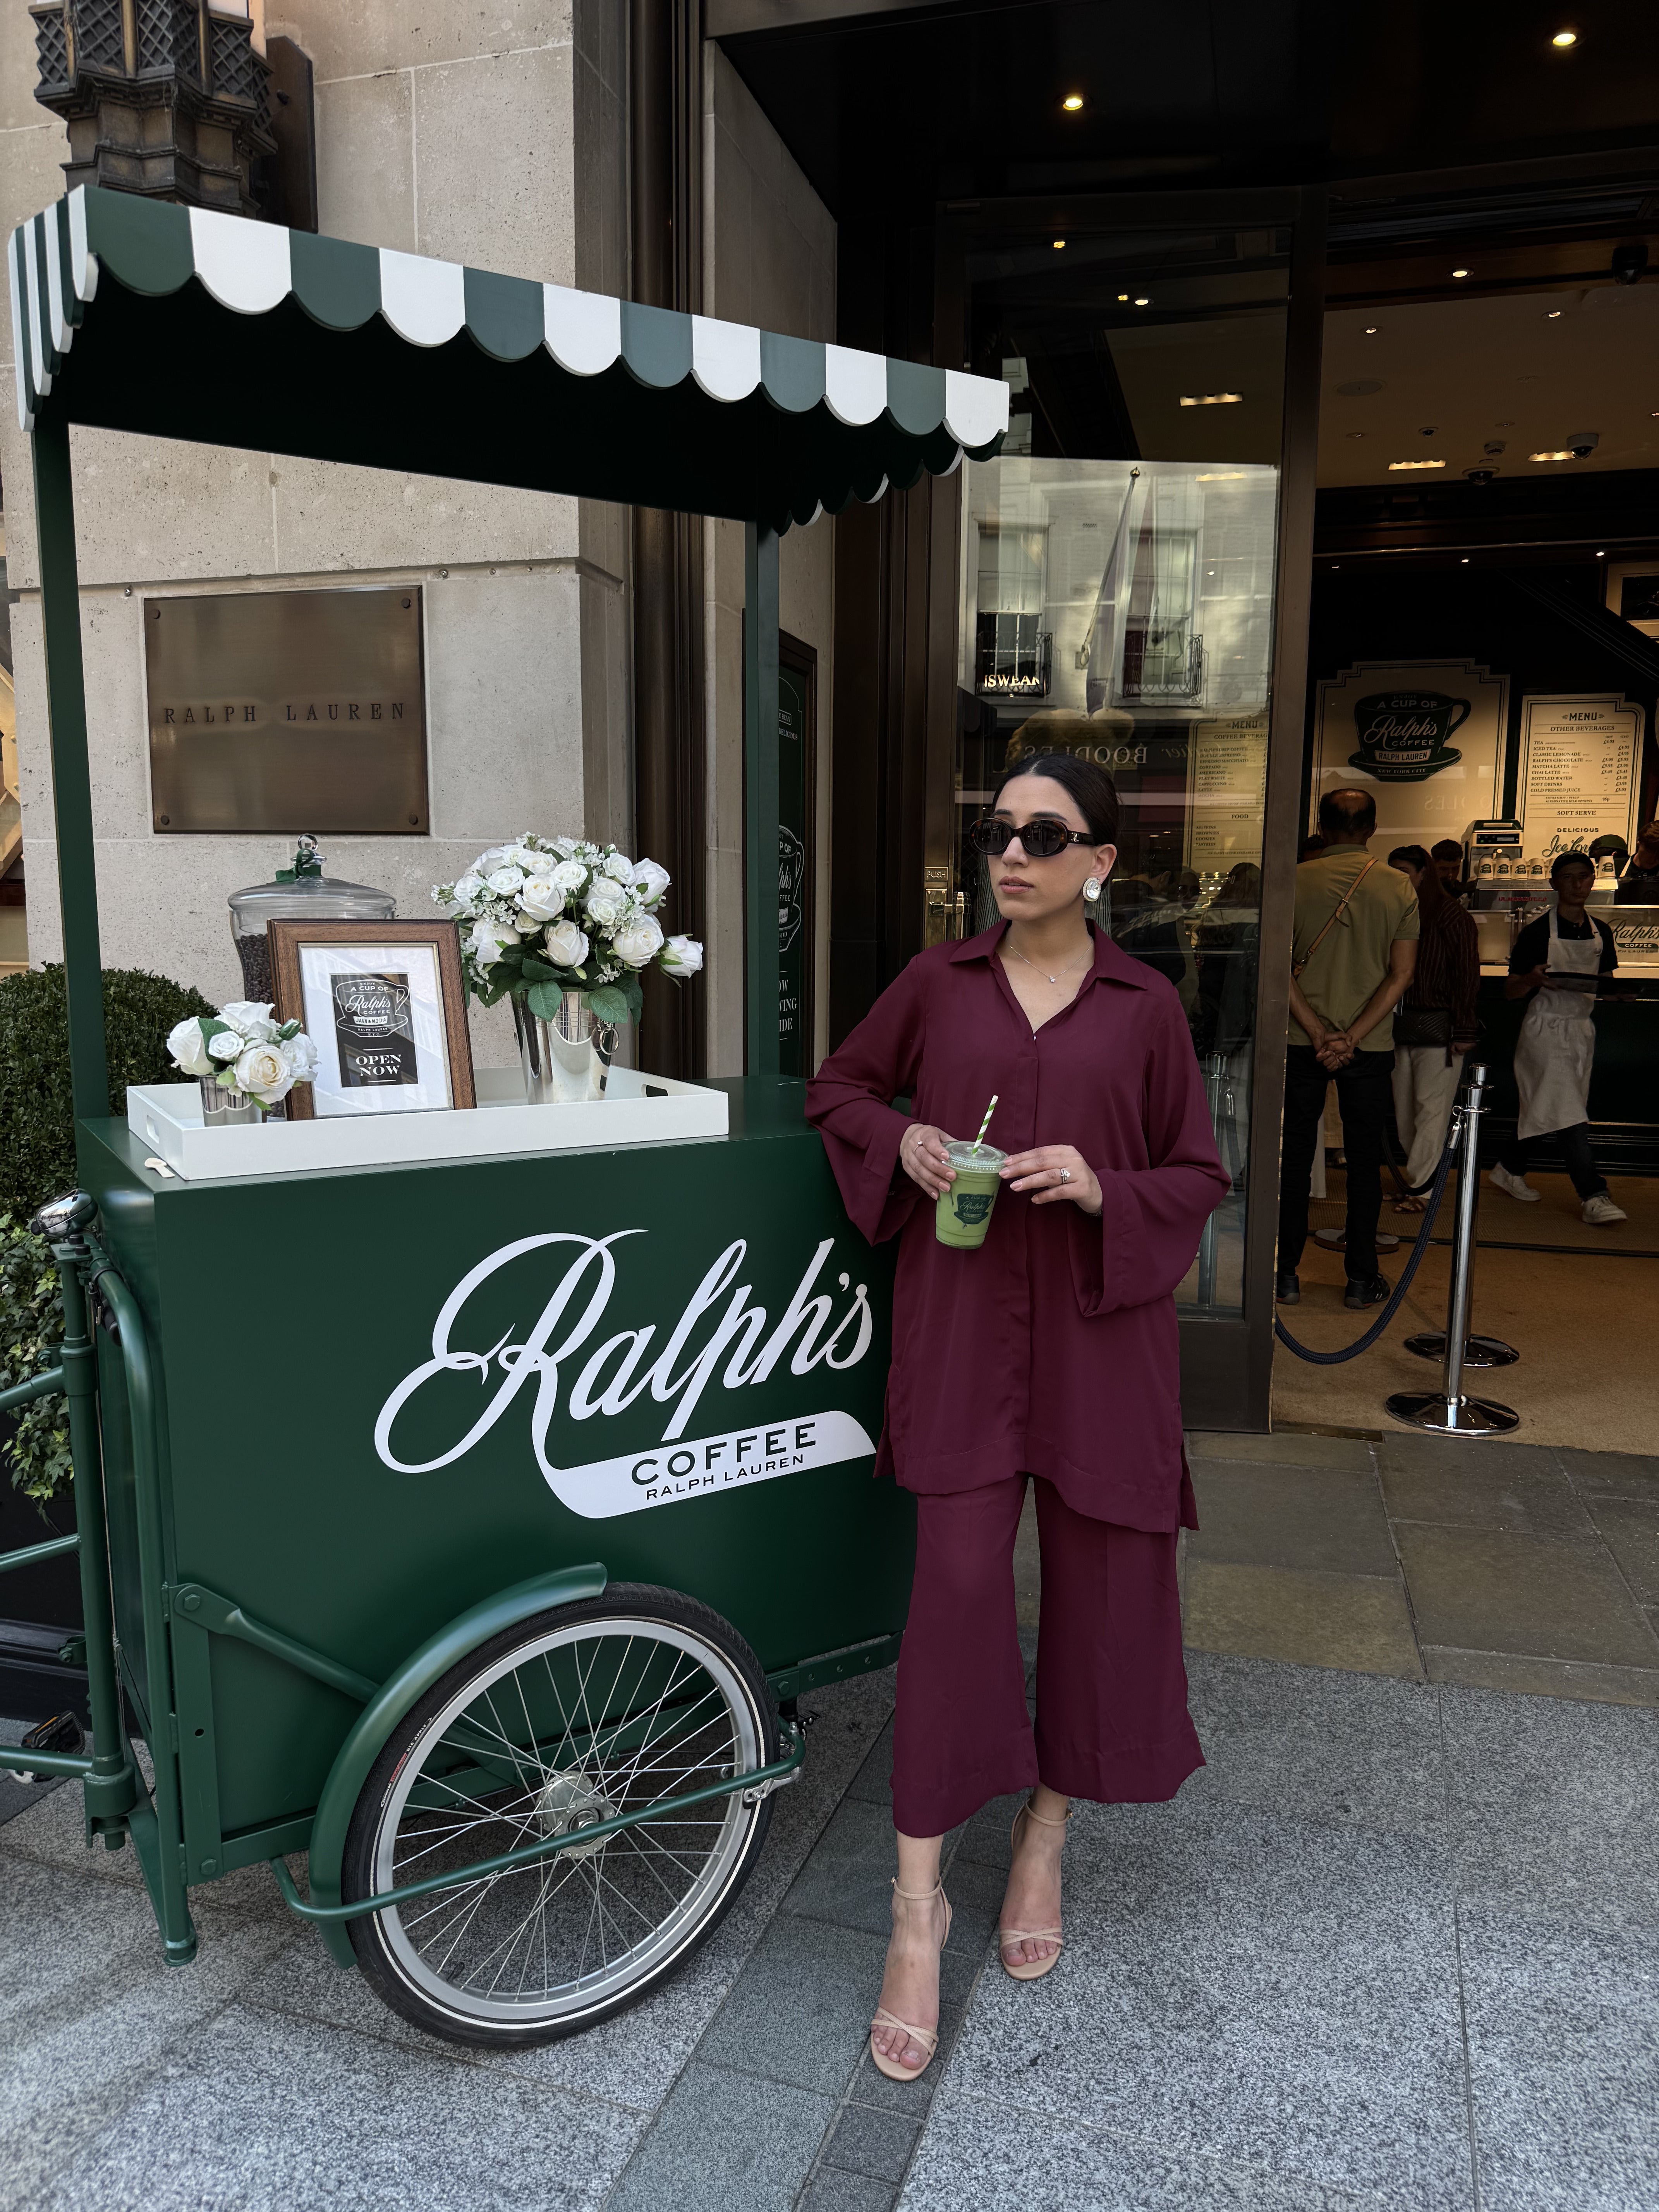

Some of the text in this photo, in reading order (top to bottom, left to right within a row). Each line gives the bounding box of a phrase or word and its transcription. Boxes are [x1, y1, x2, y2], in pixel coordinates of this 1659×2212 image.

[1421, 700, 1438, 708] OF
[164, 703, 404, 723] RALPH LAUREN
[1569, 712, 1597, 721] MENU
[1232, 721, 1258, 729] MENU
[1364, 715, 1437, 750] Ralph's
[1401, 752, 1427, 761] LAUREN
[784, 843, 791, 855] OF
[345, 994, 390, 1017] Ralph's
[779, 1018, 792, 1032] IDE
[356, 1054, 402, 1065] OPEN
[359, 1065, 400, 1076] NOW
[374, 1229, 872, 1474] Ralph's
[631, 1422, 816, 1486] COFFEE
[646, 1453, 804, 1500] RALPH LAUREN
